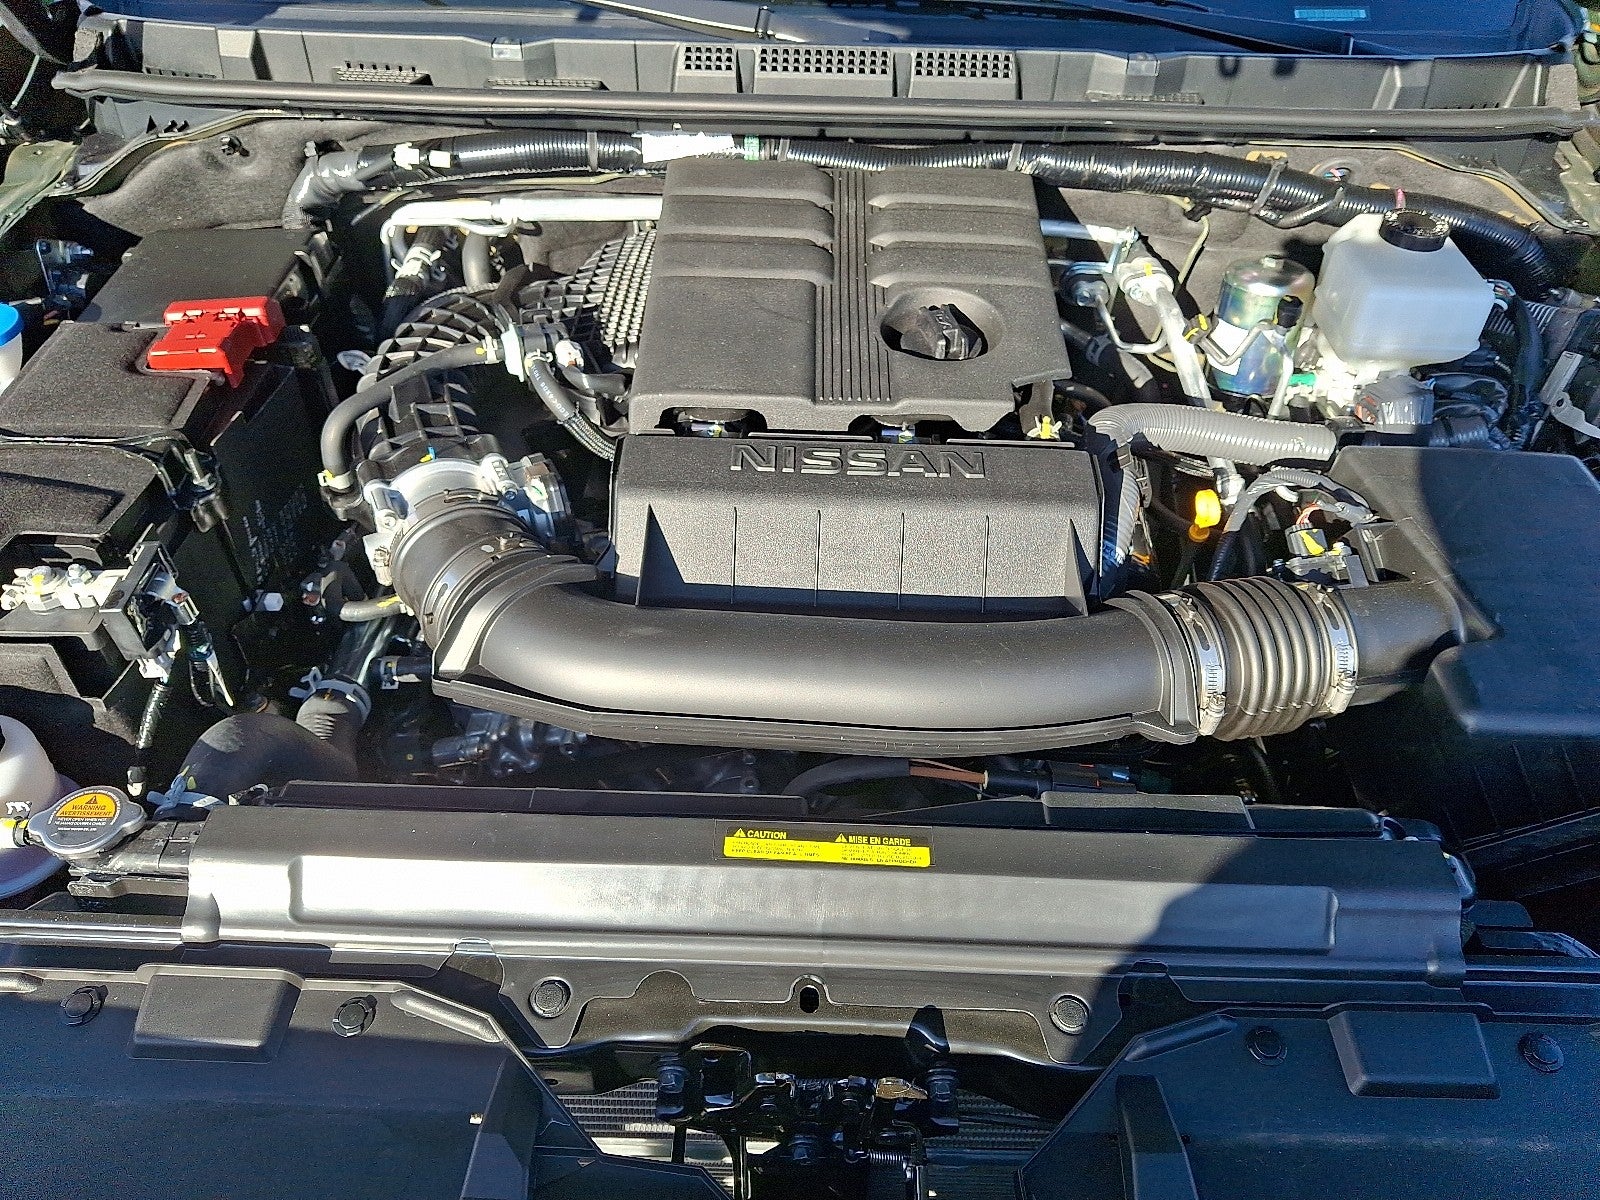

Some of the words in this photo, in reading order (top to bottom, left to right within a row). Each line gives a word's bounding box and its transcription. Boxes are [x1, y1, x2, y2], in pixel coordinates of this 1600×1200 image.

[729, 444, 986, 479] NISSAN
[747, 830, 787, 840] CAUTION
[848, 835, 870, 845] MISE
[870, 837, 882, 845] EN
[882, 837, 911, 847] GARDE
